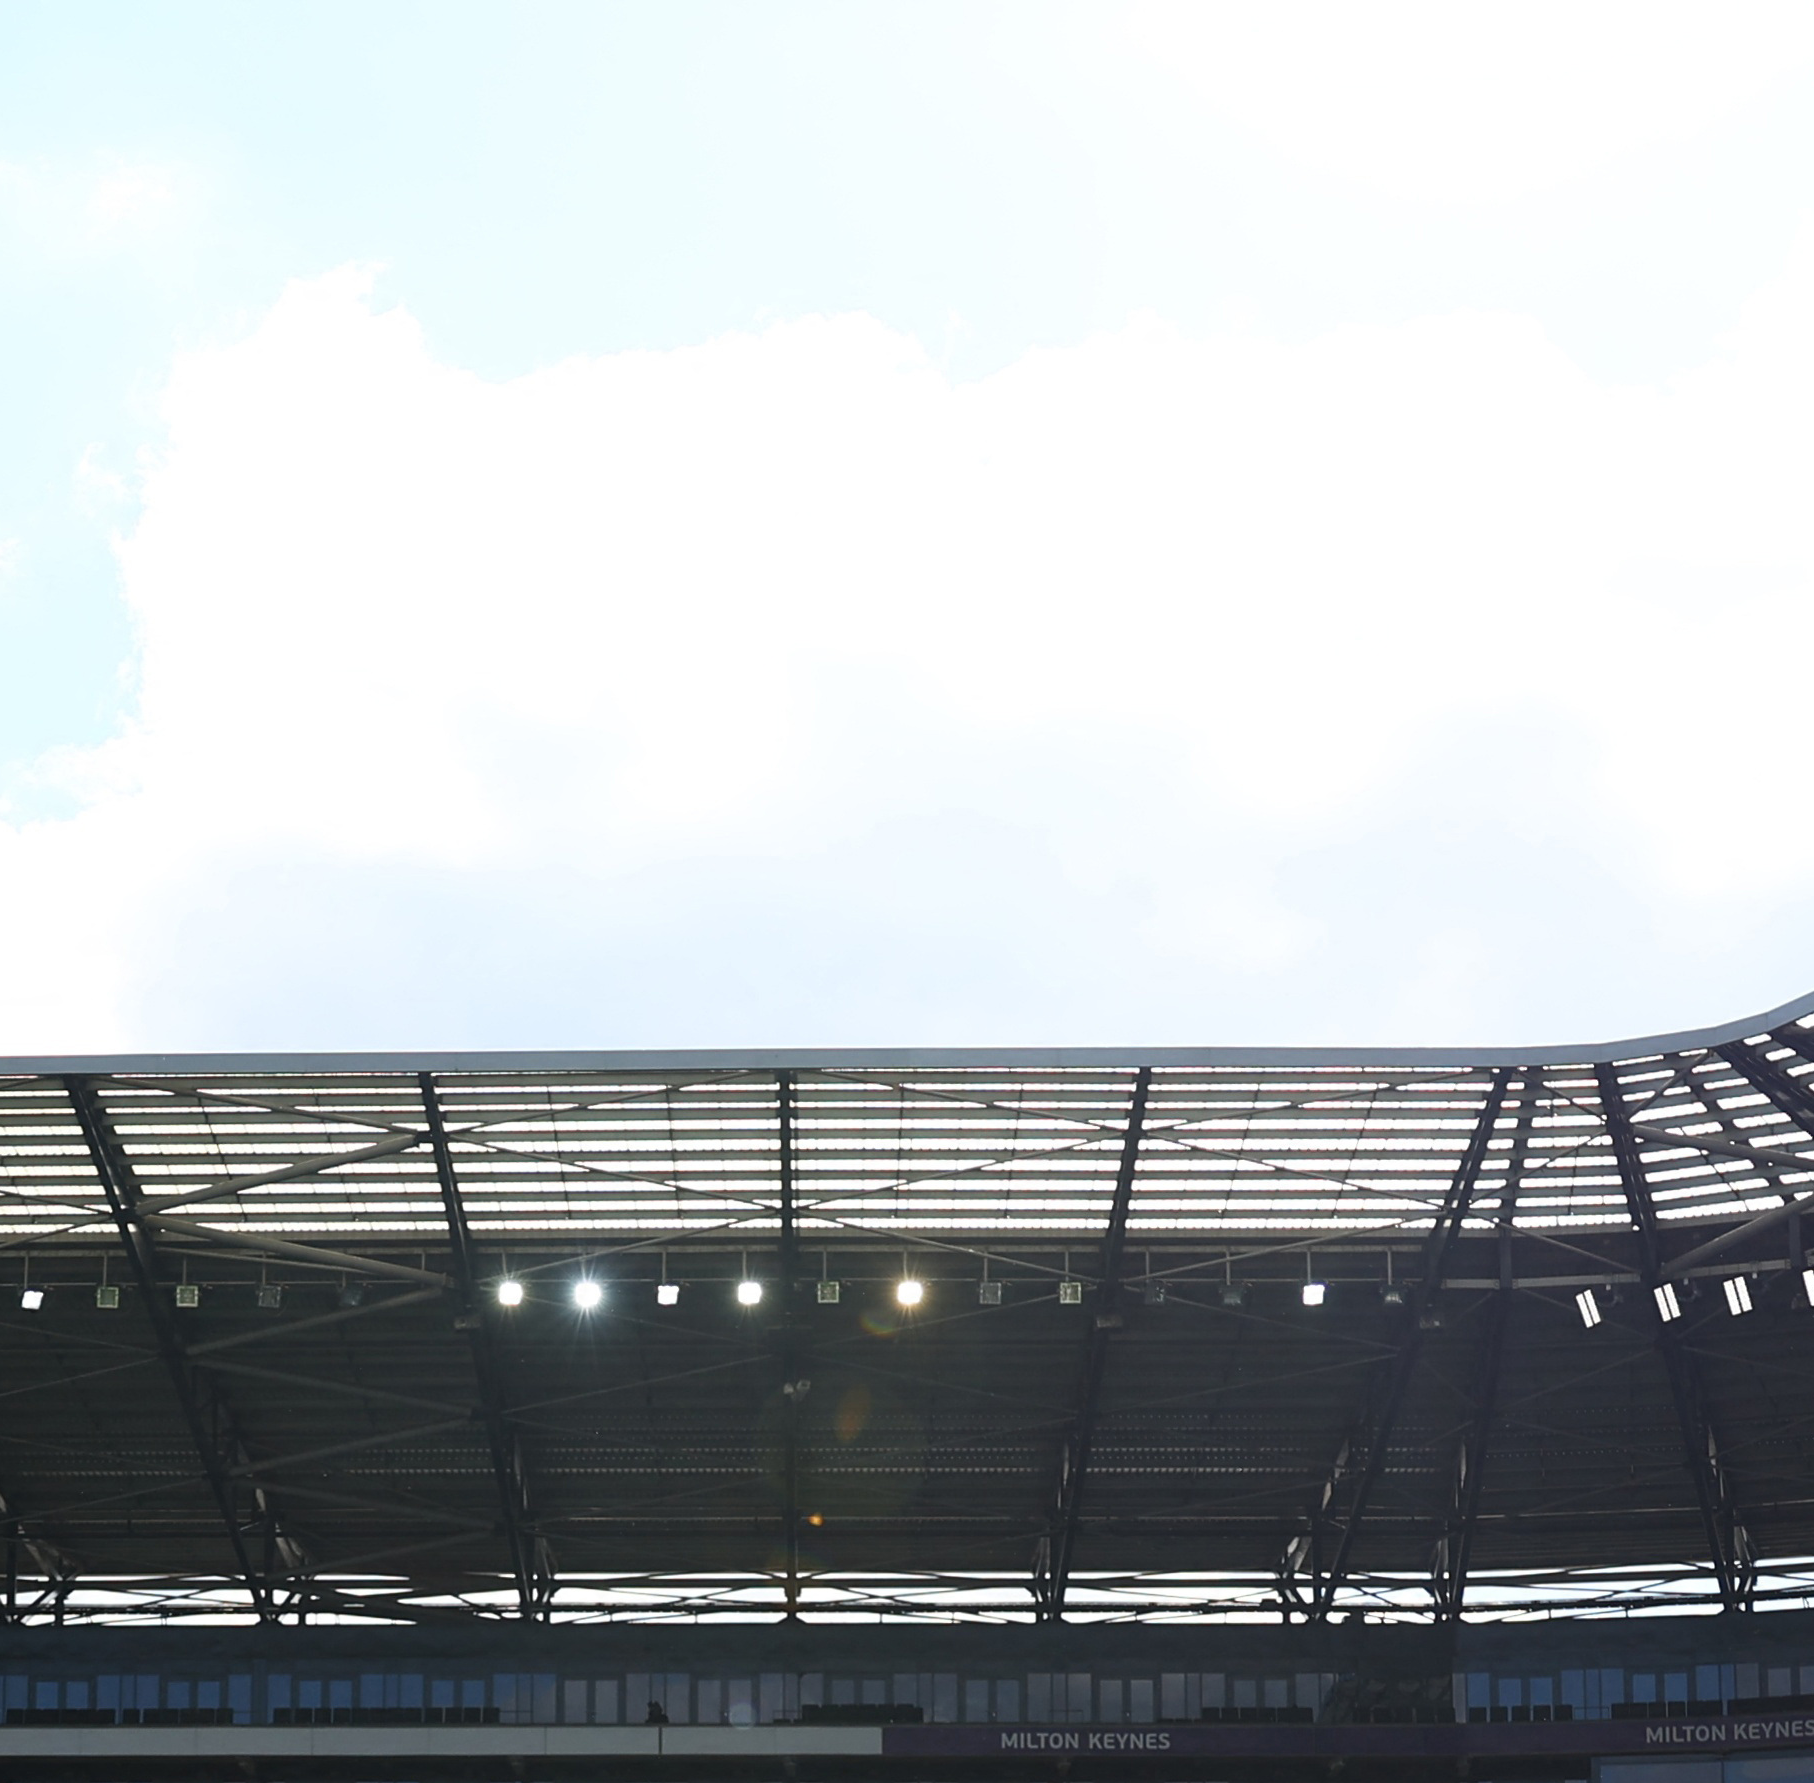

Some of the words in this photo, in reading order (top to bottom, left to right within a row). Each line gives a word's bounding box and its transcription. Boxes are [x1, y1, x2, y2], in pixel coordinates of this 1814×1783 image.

[1001, 1732, 1079, 1750] MILTON
[1089, 1732, 1171, 1750] KEYNES
[1645, 1723, 1726, 1744] MILTON
